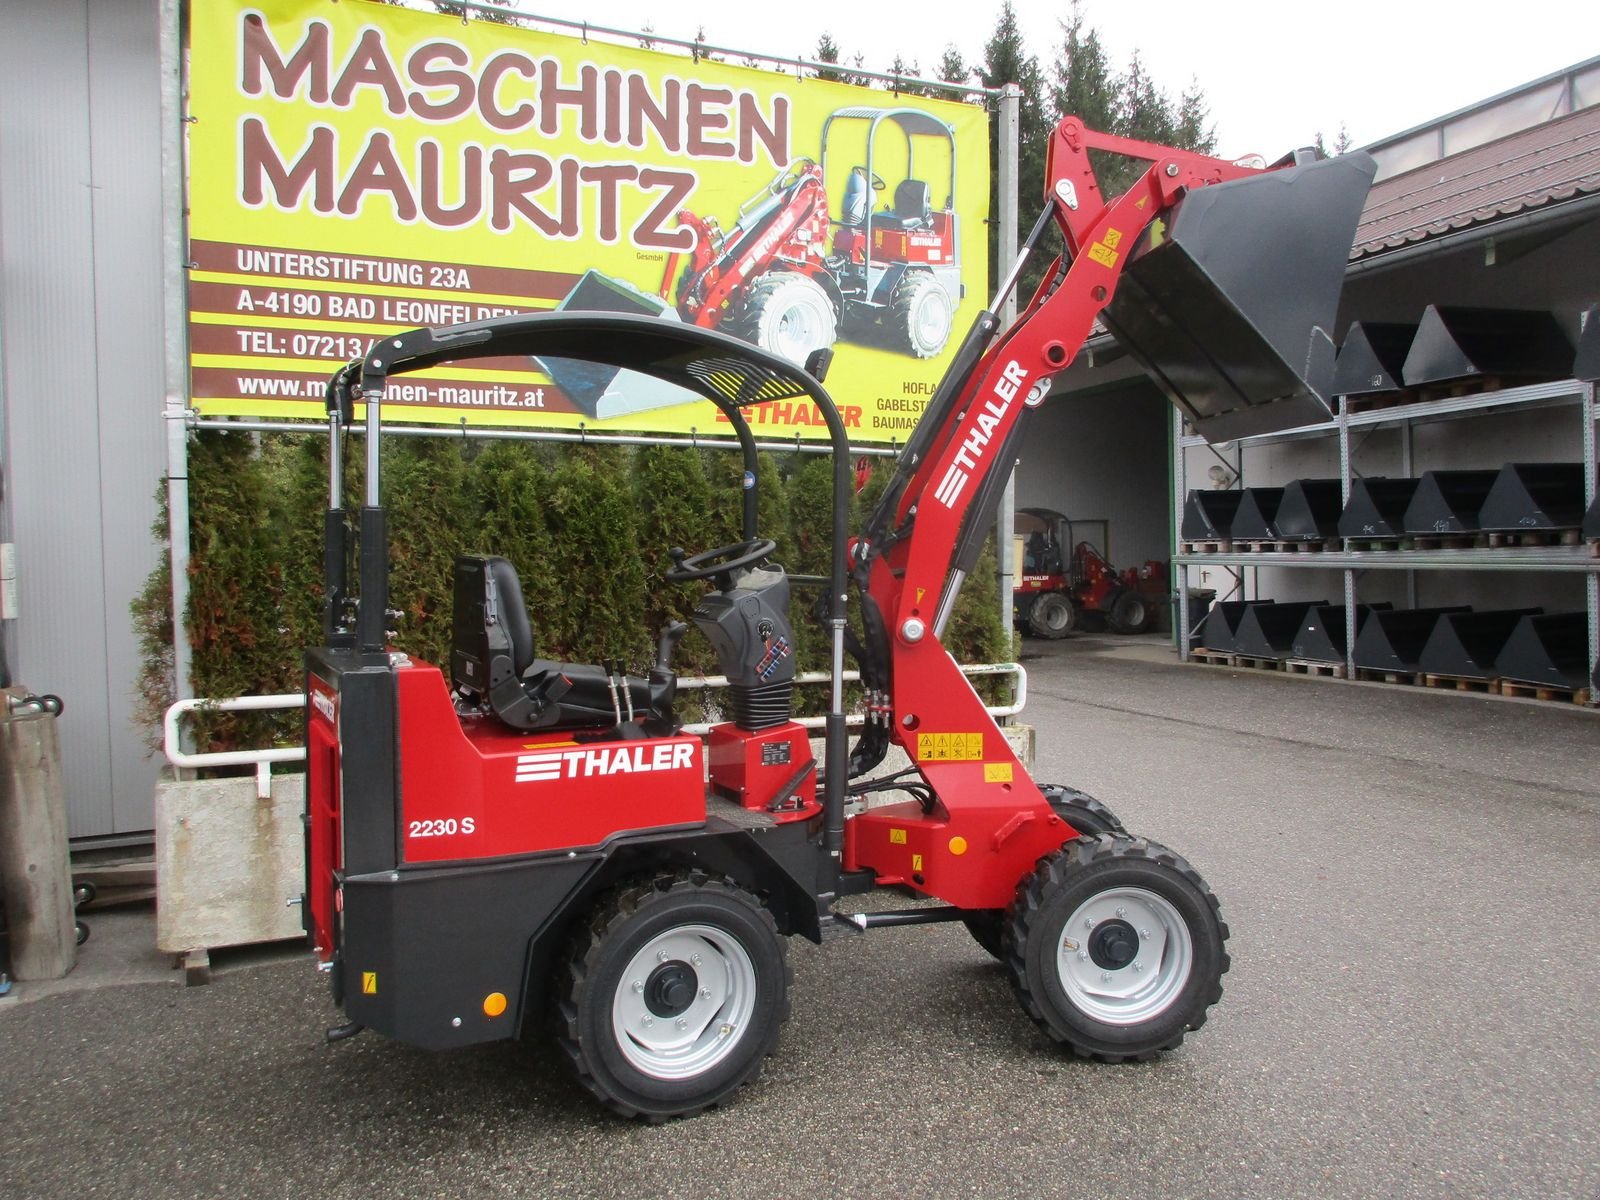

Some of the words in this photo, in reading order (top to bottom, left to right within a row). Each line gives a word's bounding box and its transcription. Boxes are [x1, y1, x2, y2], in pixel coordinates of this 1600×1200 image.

[242, 14, 788, 167] MASCHINEN
[242, 117, 696, 249] MAURITZ
[237, 249, 423, 285] UNTERSTIFTUNG
[430, 267, 470, 289] 23A
[237, 289, 321, 316] A-4190
[328, 296, 375, 319] BAD
[237, 331, 286, 354] TEL:
[752, 402, 862, 428] THALR
[877, 398, 929, 412] GABELST
[953, 359, 1028, 470] THALER
[563, 743, 694, 777] THALER
[409, 820, 457, 837] 2230
[460, 817, 475, 834] S
